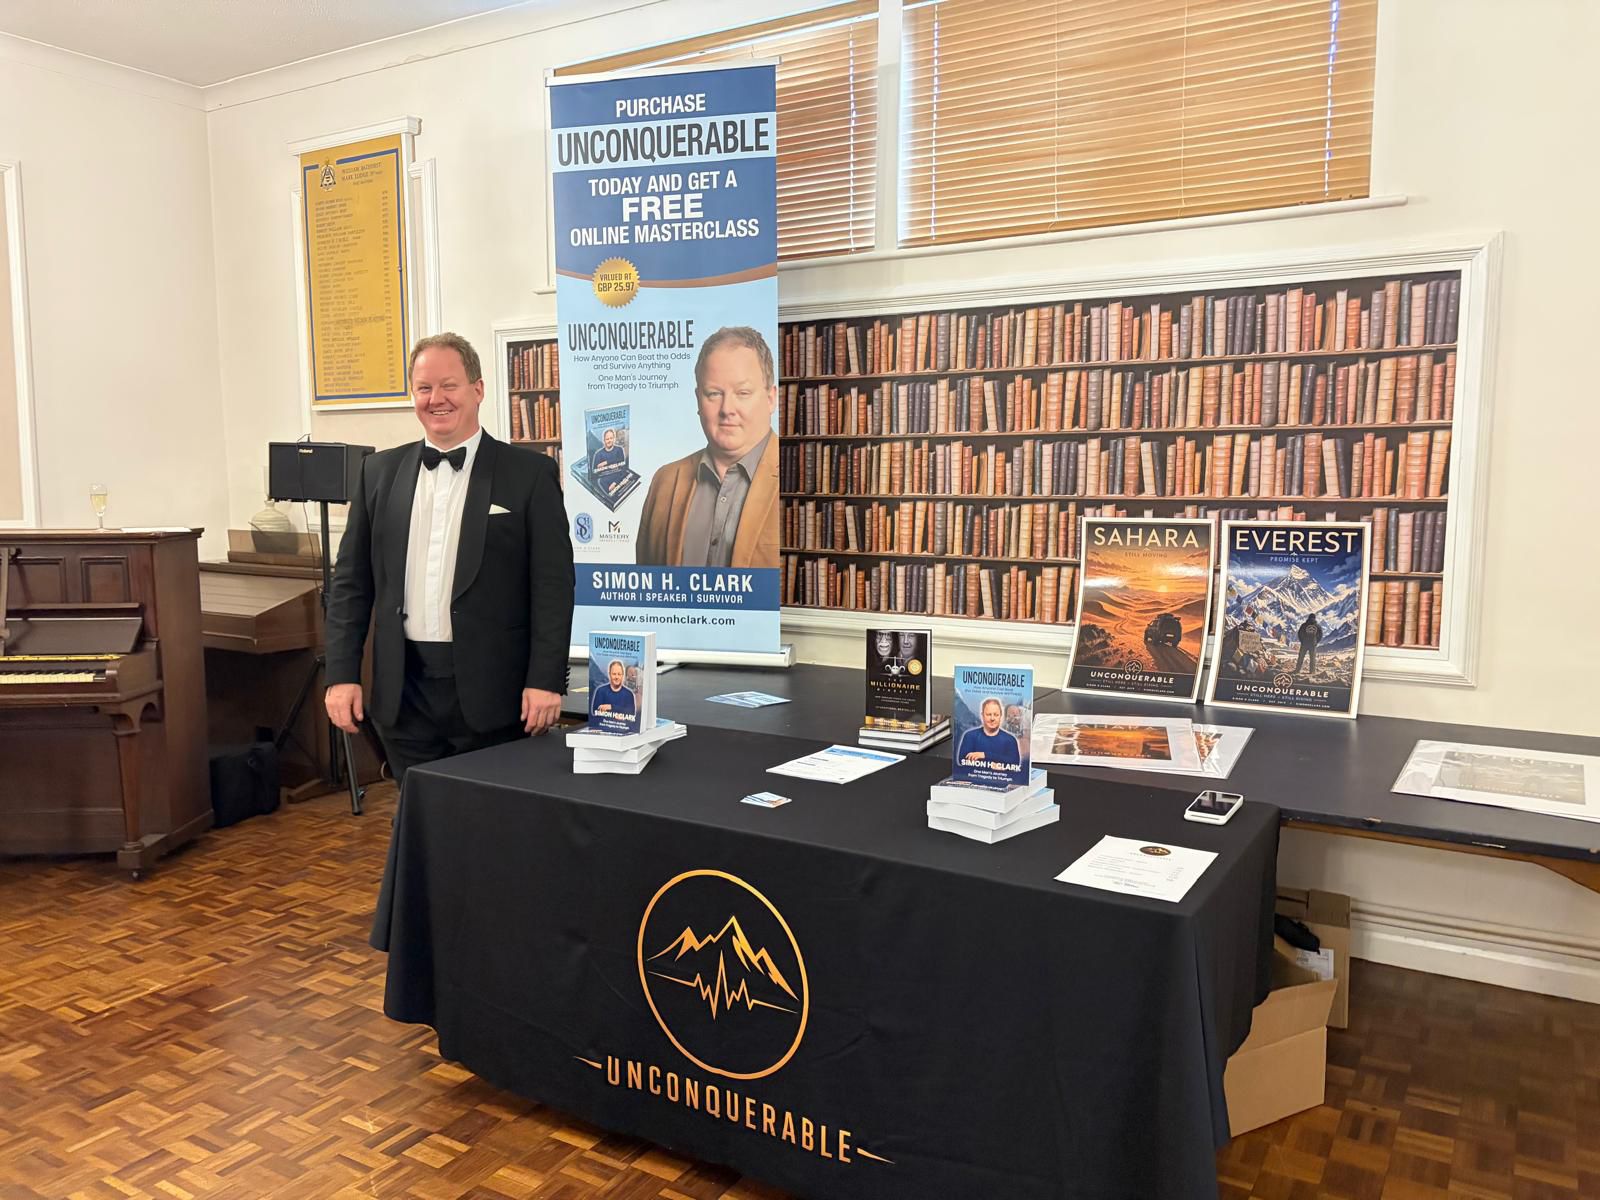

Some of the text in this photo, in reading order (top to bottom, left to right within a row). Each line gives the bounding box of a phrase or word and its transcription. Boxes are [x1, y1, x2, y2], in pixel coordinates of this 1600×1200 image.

[616, 93, 706, 118] PURCHASE
[557, 118, 769, 167] UNCONQUERABLE
[588, 170, 738, 197] TODAY AND GET A
[622, 193, 704, 222] FREE
[570, 218, 759, 247] ONLINE MASTERCLASS
[600, 272, 632, 281] VALUED AT
[597, 281, 635, 292] GBP 25.97
[568, 319, 694, 351] UNCONQUERABLE
[573, 352, 691, 365] How Anyone Can Beat the Odds
[593, 361, 671, 371] and Survive Anything
[598, 373, 668, 382] One Man's Journey
[607, 382, 638, 392] Tragedy
[638, 382, 647, 390] to
[648, 381, 679, 391] Triumph
[591, 409, 627, 425] UNCONQUERABLE
[1093, 526, 1199, 548] SAHARA
[1235, 530, 1358, 553] EVEREST
[592, 571, 754, 593] SIMON H. CLARK
[600, 592, 744, 604] AUTHOR SPEAKER SURVIVOR
[609, 613, 736, 626] www.simonhclark.com
[594, 636, 641, 653] UNCONQUERABLE
[870, 680, 921, 691] MILLIONAIRE
[962, 670, 1026, 688] UNCONQUERABLE
[1090, 671, 1175, 684] UNCONQUERABLE
[1236, 684, 1329, 699] UNCONQUERABLE
[961, 758, 987, 768] SIMON
[996, 762, 1022, 772] CLARK
[606, 1055, 852, 1164] UNCONQUERABLE
